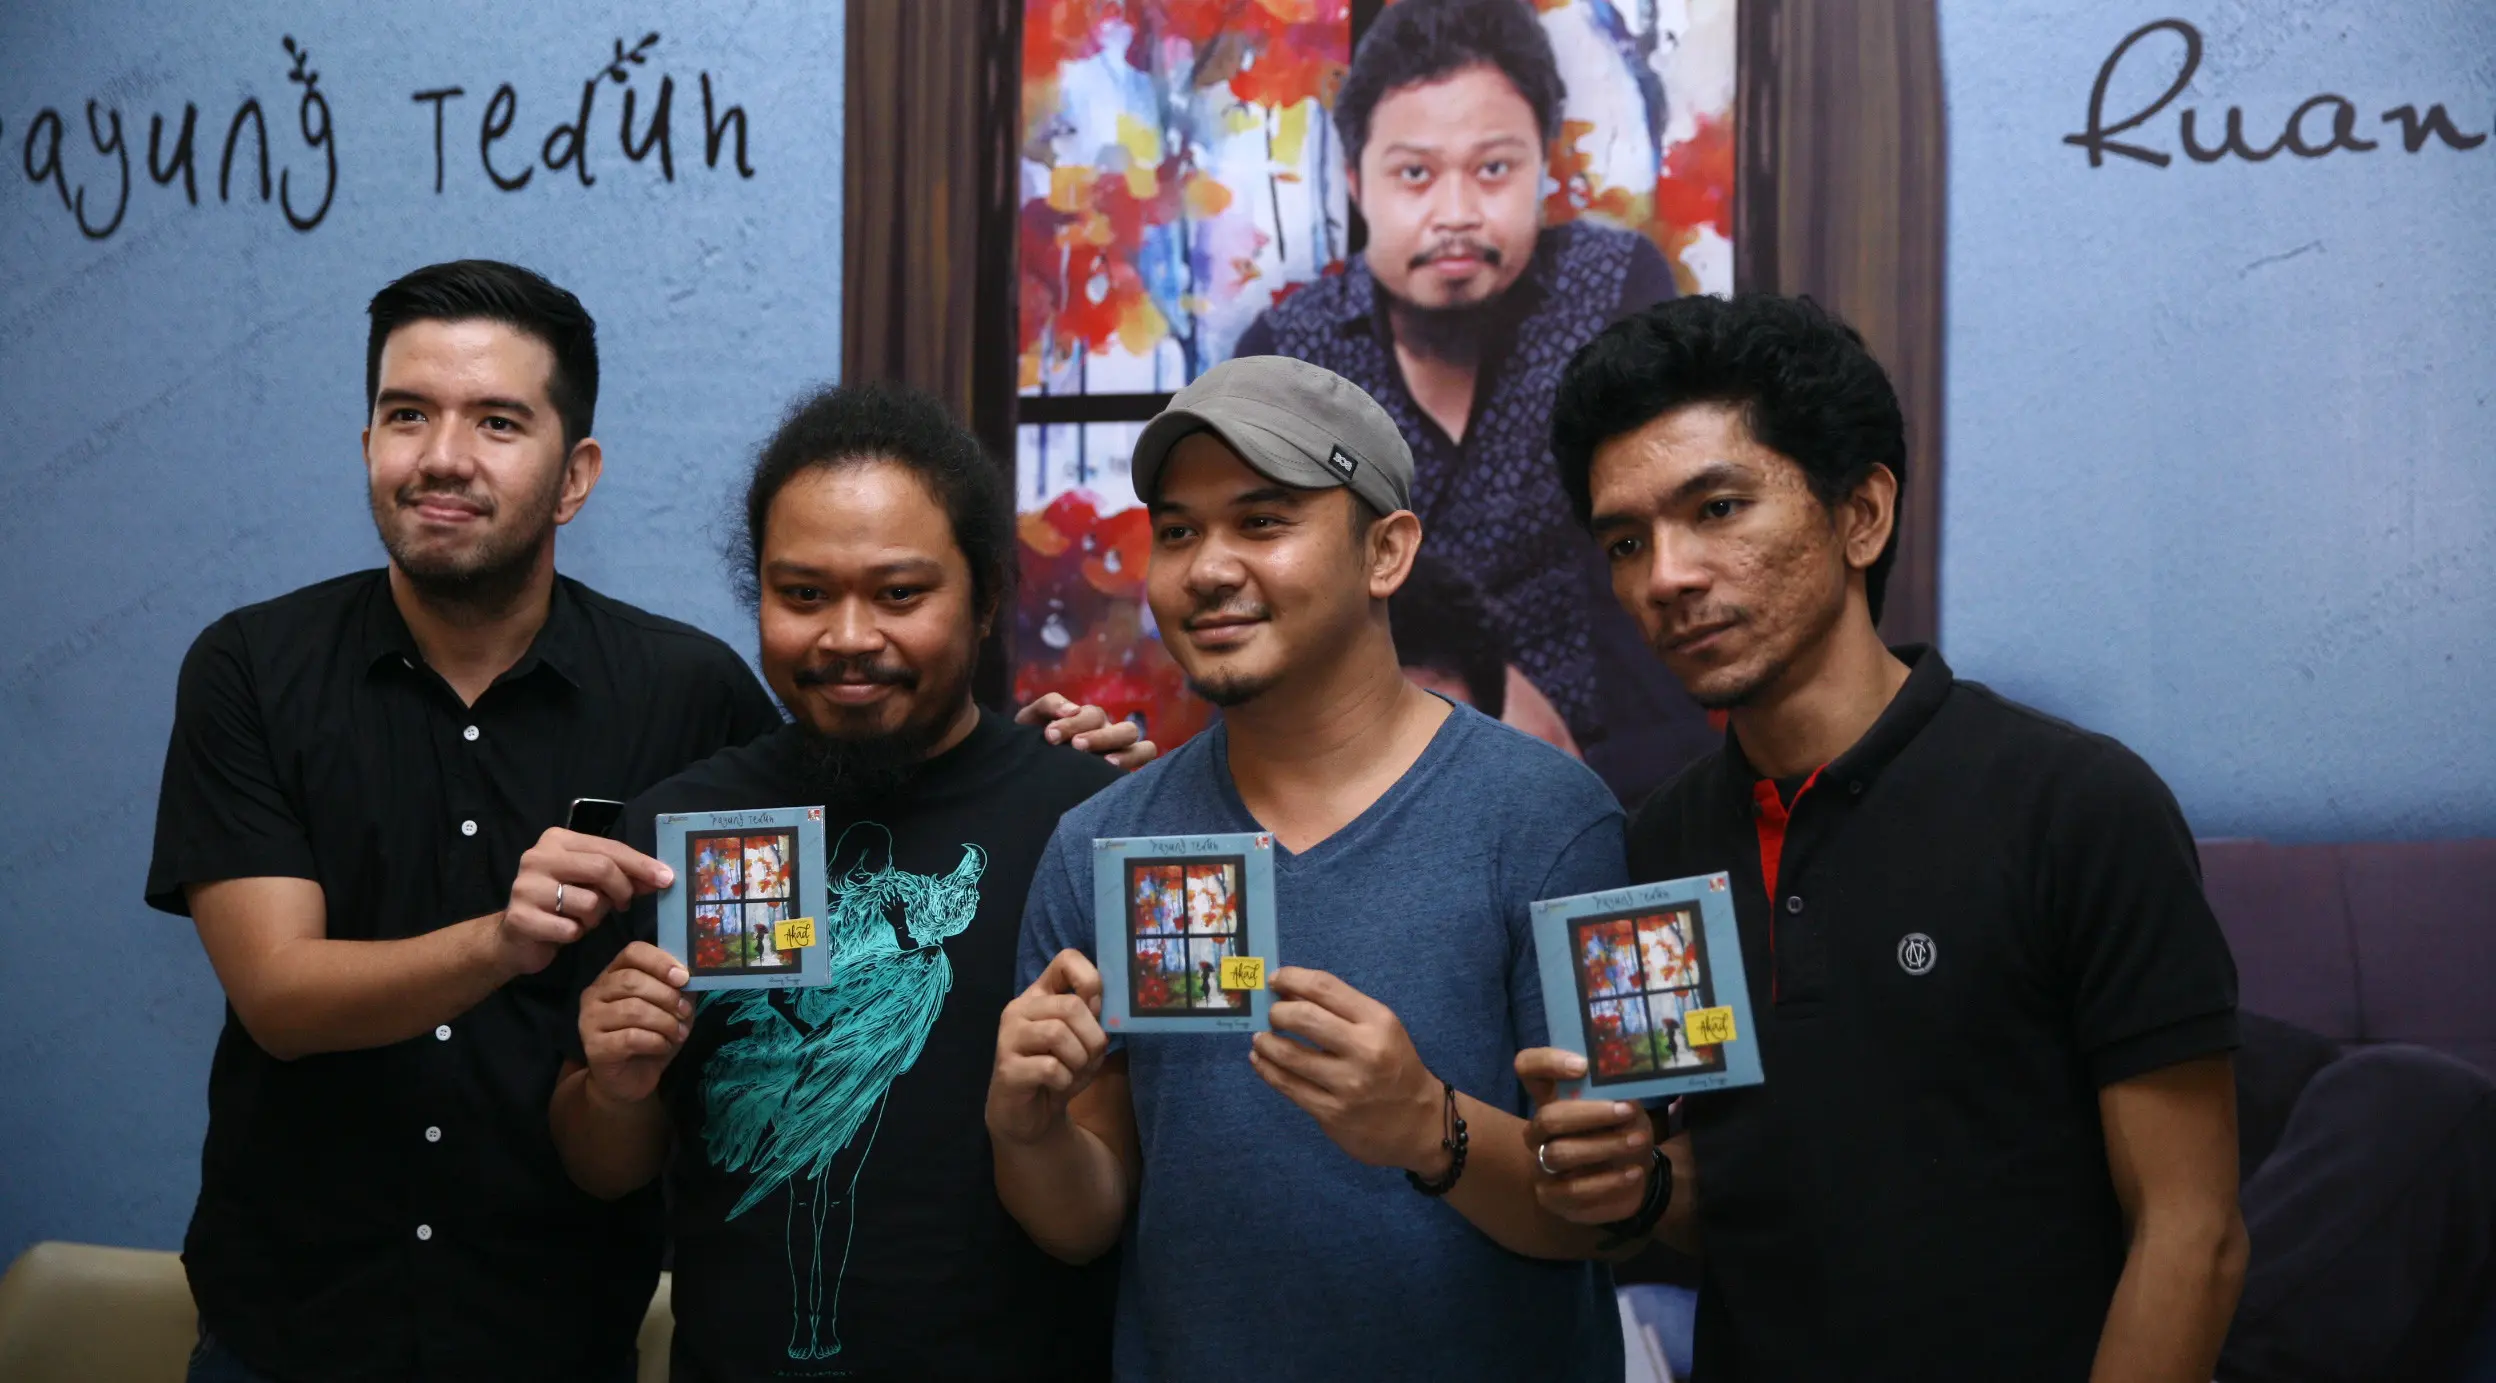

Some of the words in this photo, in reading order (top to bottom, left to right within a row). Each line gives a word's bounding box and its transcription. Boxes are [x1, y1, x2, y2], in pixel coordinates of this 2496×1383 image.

[0, 35, 337, 240] ayung
[411, 33, 755, 194] Teduh
[2062, 17, 2496, 168] Ruan
